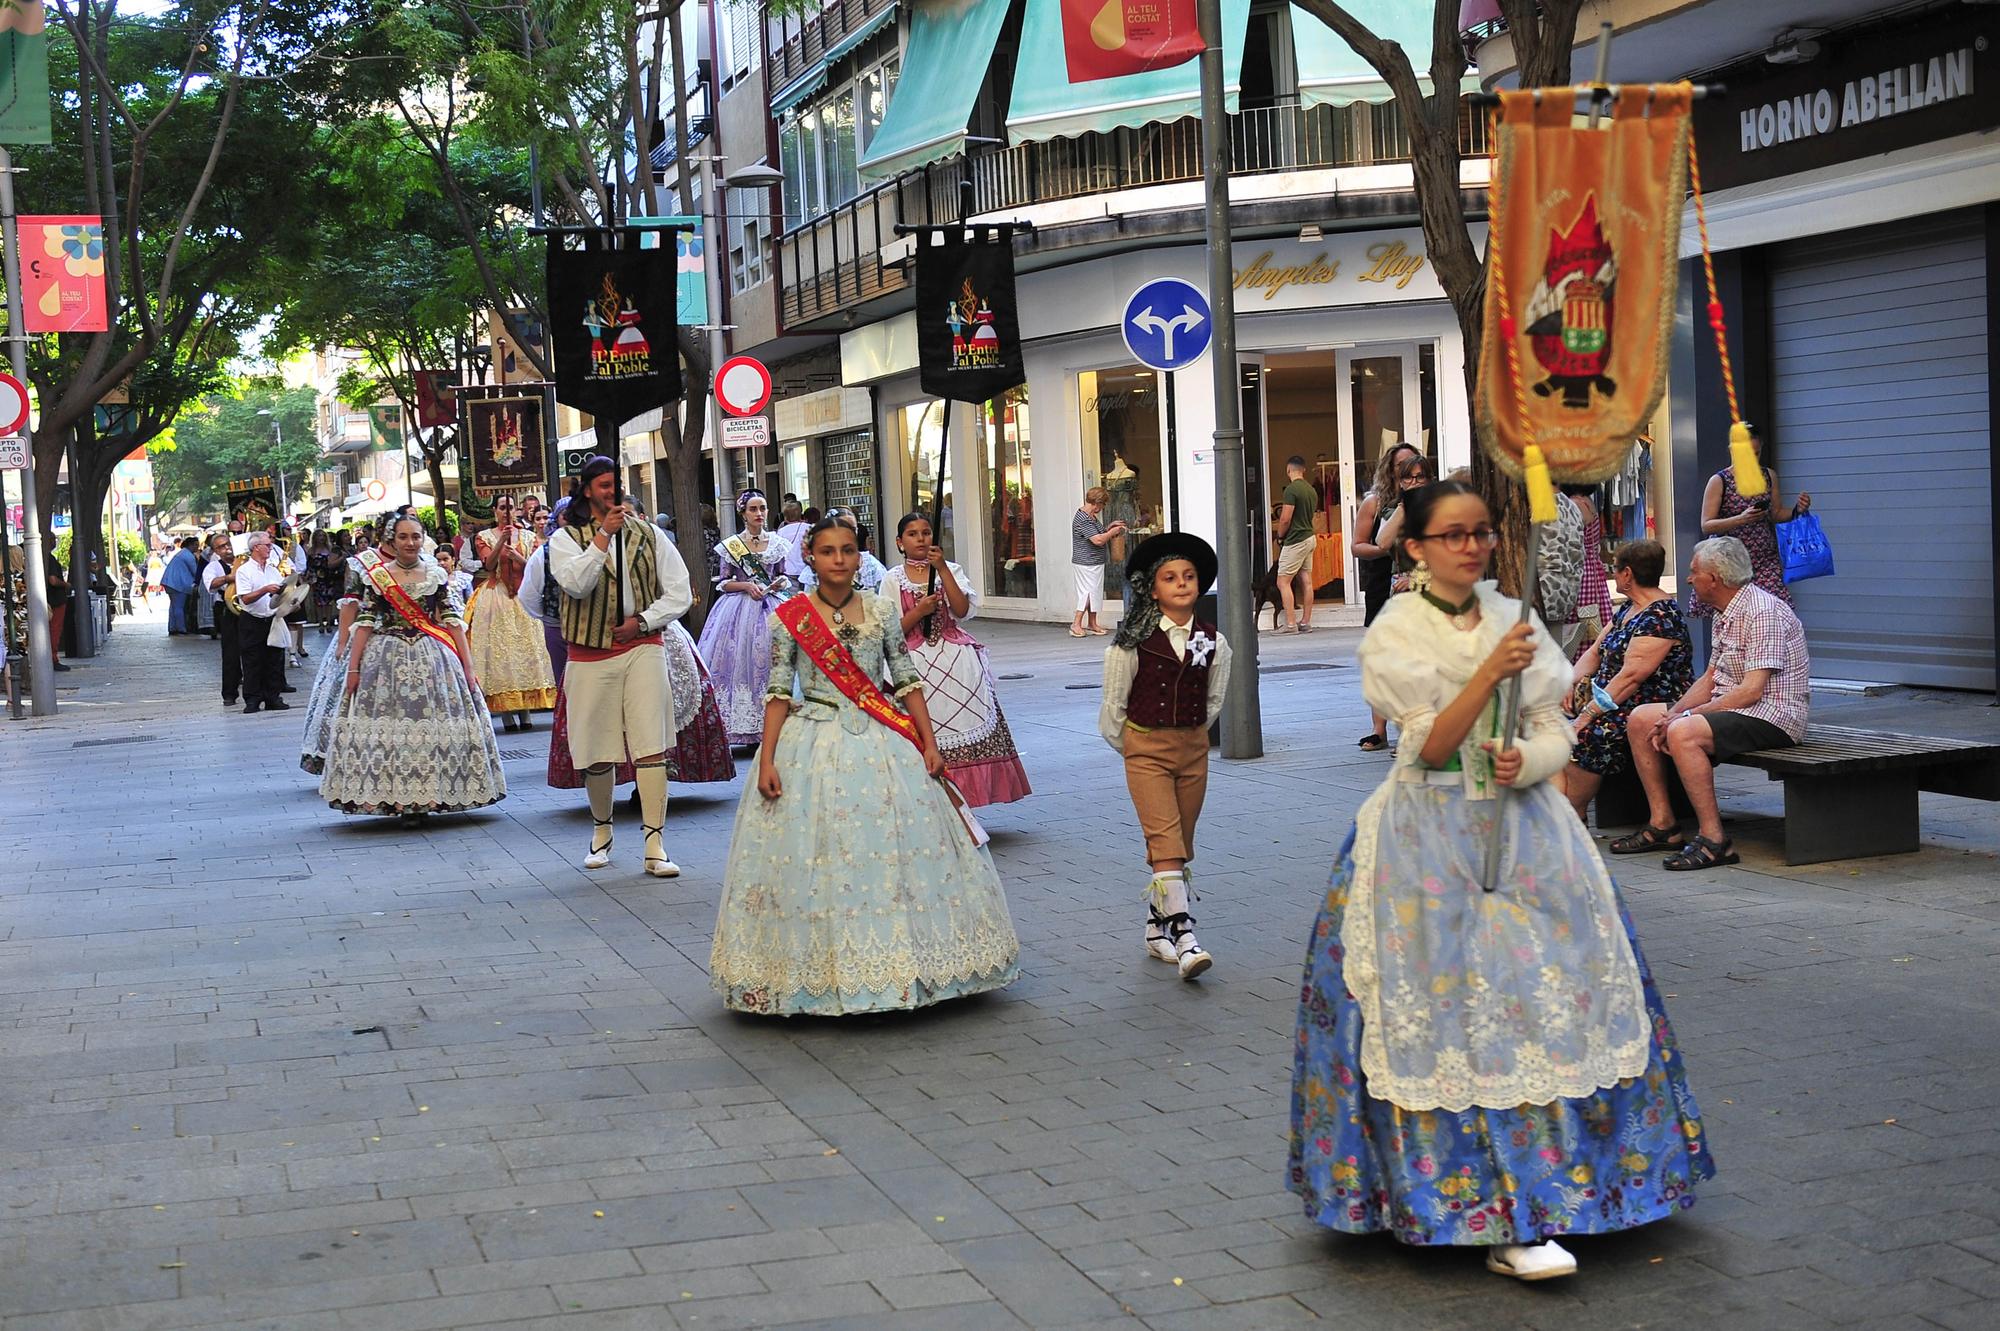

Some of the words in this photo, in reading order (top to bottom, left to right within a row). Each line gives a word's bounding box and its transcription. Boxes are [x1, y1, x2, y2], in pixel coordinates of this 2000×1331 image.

[1140, 4, 1157, 13] TEU
[1128, 14, 1160, 23] COSTAT
[1740, 88, 1836, 152] HORNO
[1841, 48, 1974, 128] ABELLAN
[596, 346, 649, 363] L'Entrà
[959, 355, 969, 366] al
[972, 354, 999, 365] Poble
[598, 363, 611, 375] al
[614, 361, 649, 375] Poble
